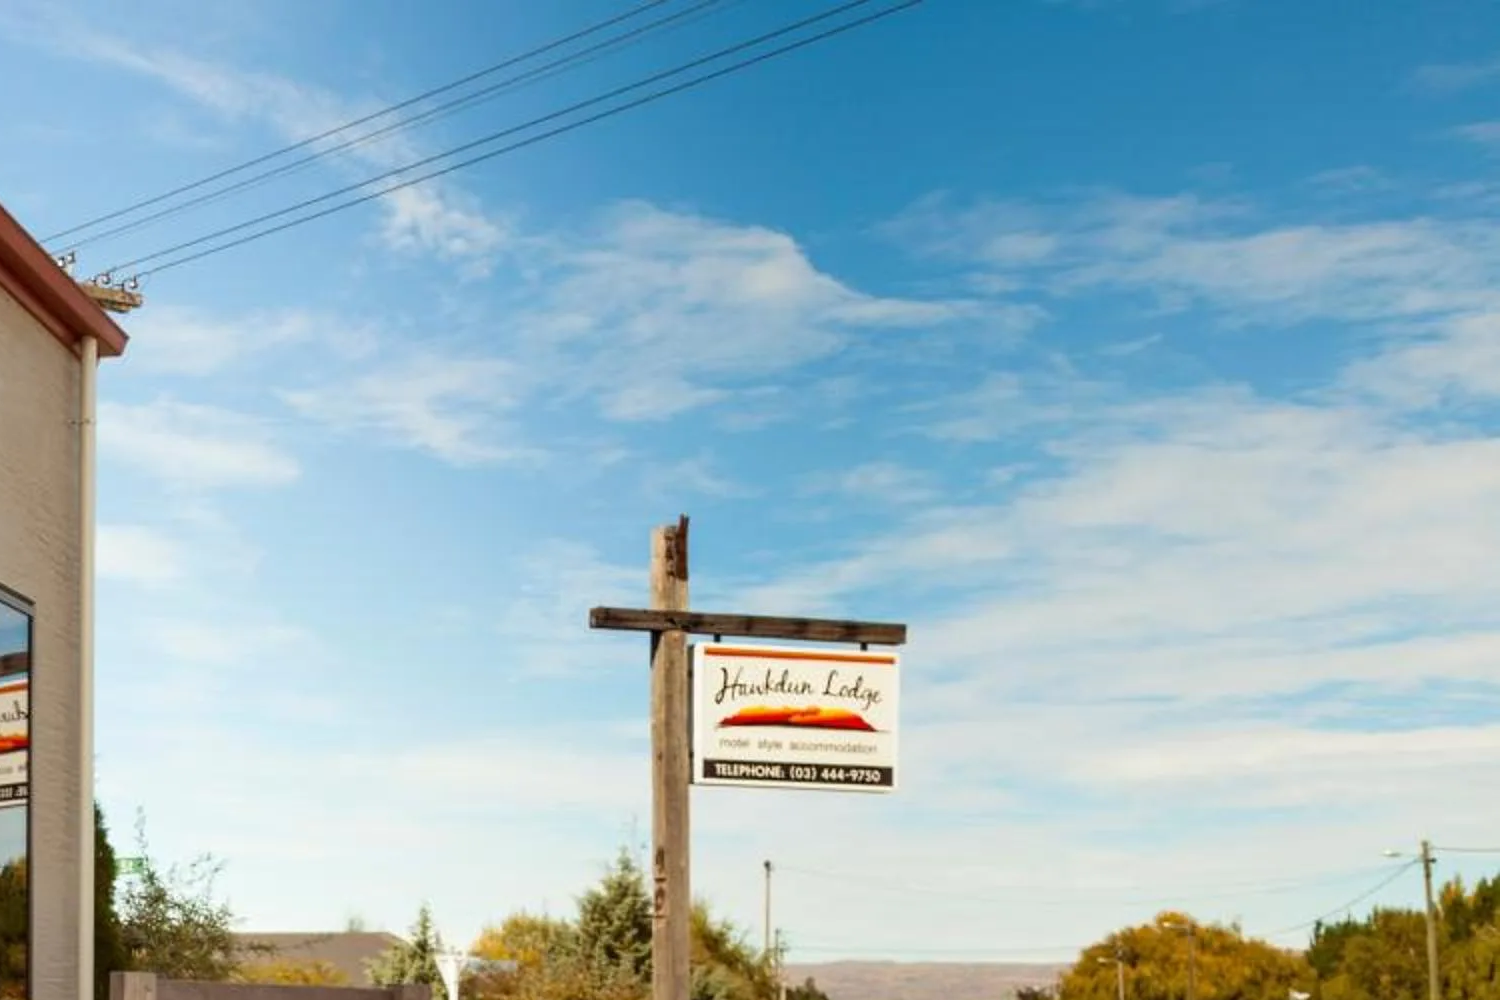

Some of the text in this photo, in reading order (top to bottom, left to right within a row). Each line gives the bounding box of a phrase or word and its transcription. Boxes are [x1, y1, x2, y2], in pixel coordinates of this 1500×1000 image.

[714, 666, 883, 711] Hawkdun Lodge
[714, 763, 881, 783] TELEPHONE: (03) 444-9750
